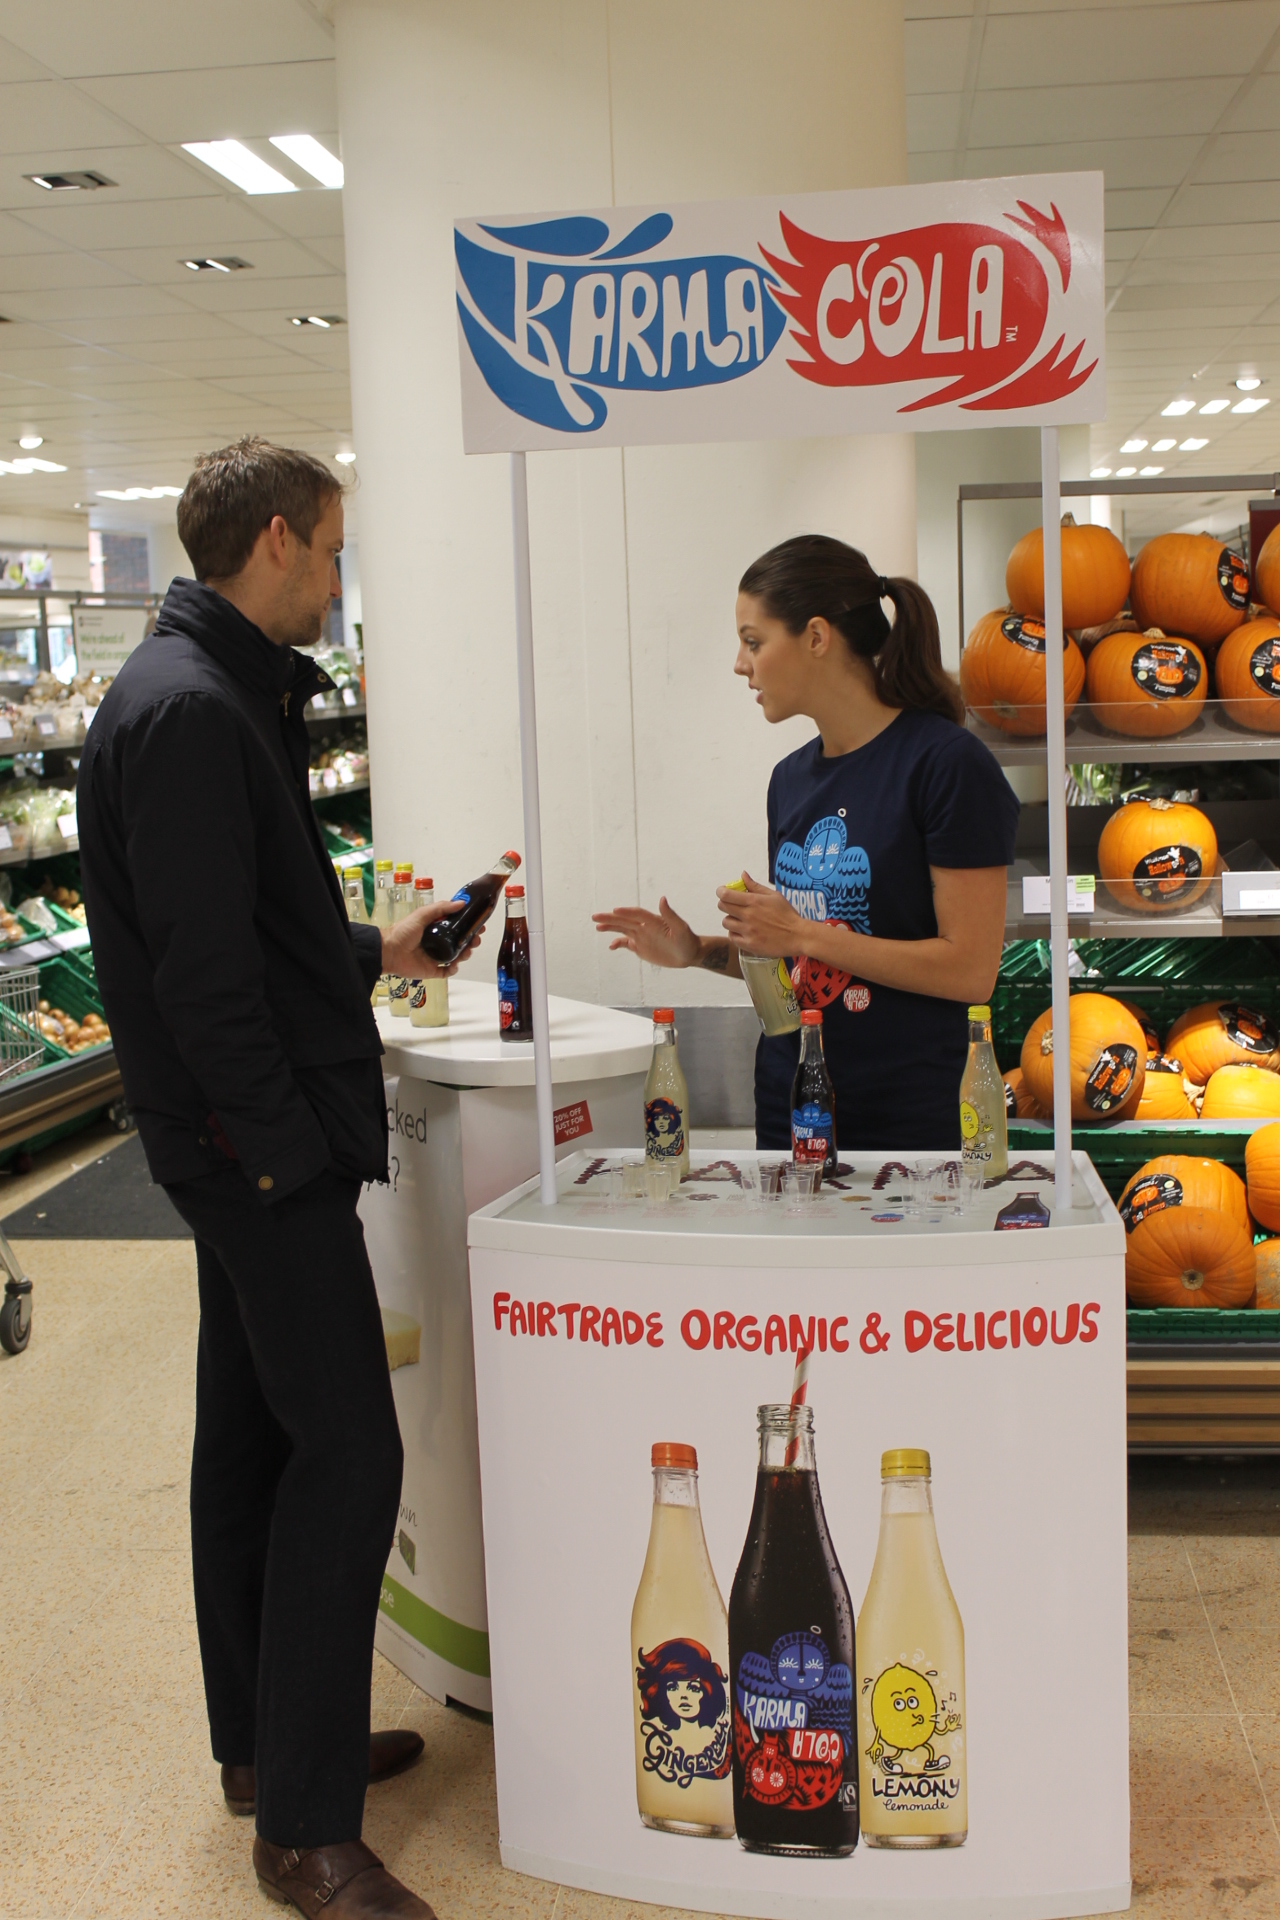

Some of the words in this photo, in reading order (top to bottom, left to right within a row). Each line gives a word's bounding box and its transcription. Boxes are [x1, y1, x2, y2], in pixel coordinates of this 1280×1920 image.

[513, 253, 765, 426] KARMA
[816, 243, 1004, 365] COLA
[1005, 325, 1018, 343] TM
[843, 988, 869, 1003] KARMA
[553, 1112, 569, 1124] 20%
[569, 1106, 582, 1117] OFF
[555, 1120, 570, 1134] JUST
[570, 1115, 585, 1126] FOR
[564, 1125, 580, 1136] YOU
[493, 1291, 665, 1348] FAIRTRADE
[680, 1309, 850, 1356] ORGANIC
[860, 1312, 890, 1355] &
[905, 1302, 1101, 1354] DELICIOUS
[743, 1691, 806, 1744] KARMA
[791, 1730, 841, 1764] COLA
[872, 1777, 961, 1799] LEMONY
